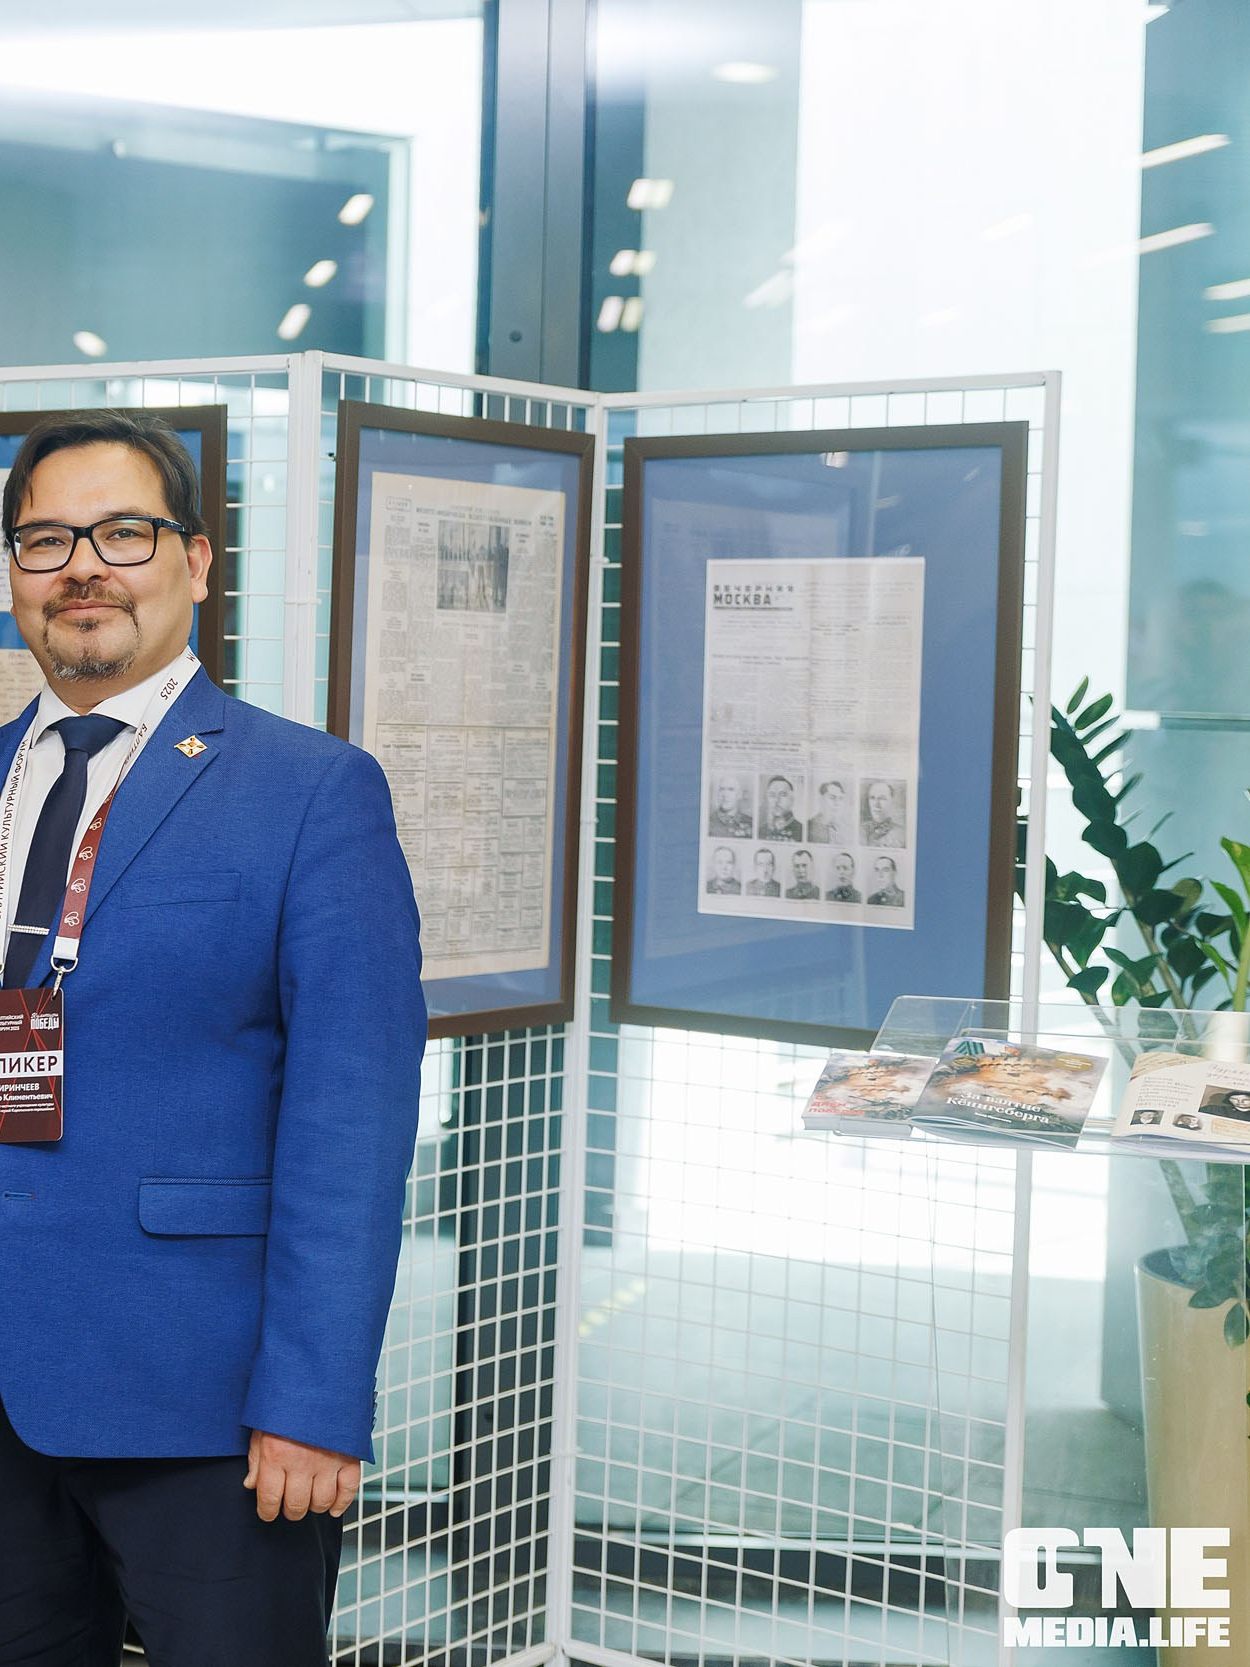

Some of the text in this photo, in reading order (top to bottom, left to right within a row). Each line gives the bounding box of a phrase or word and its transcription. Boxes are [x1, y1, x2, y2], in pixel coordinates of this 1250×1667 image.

[713, 594, 771, 605] МОСКВА
[160, 678, 179, 700] 2025
[0, 774, 21, 840] КУЛЬТУРНЫЙ
[30, 1017, 59, 1030] ПОБЕДЫ
[946, 1096, 1049, 1124] Кёнигсберга
